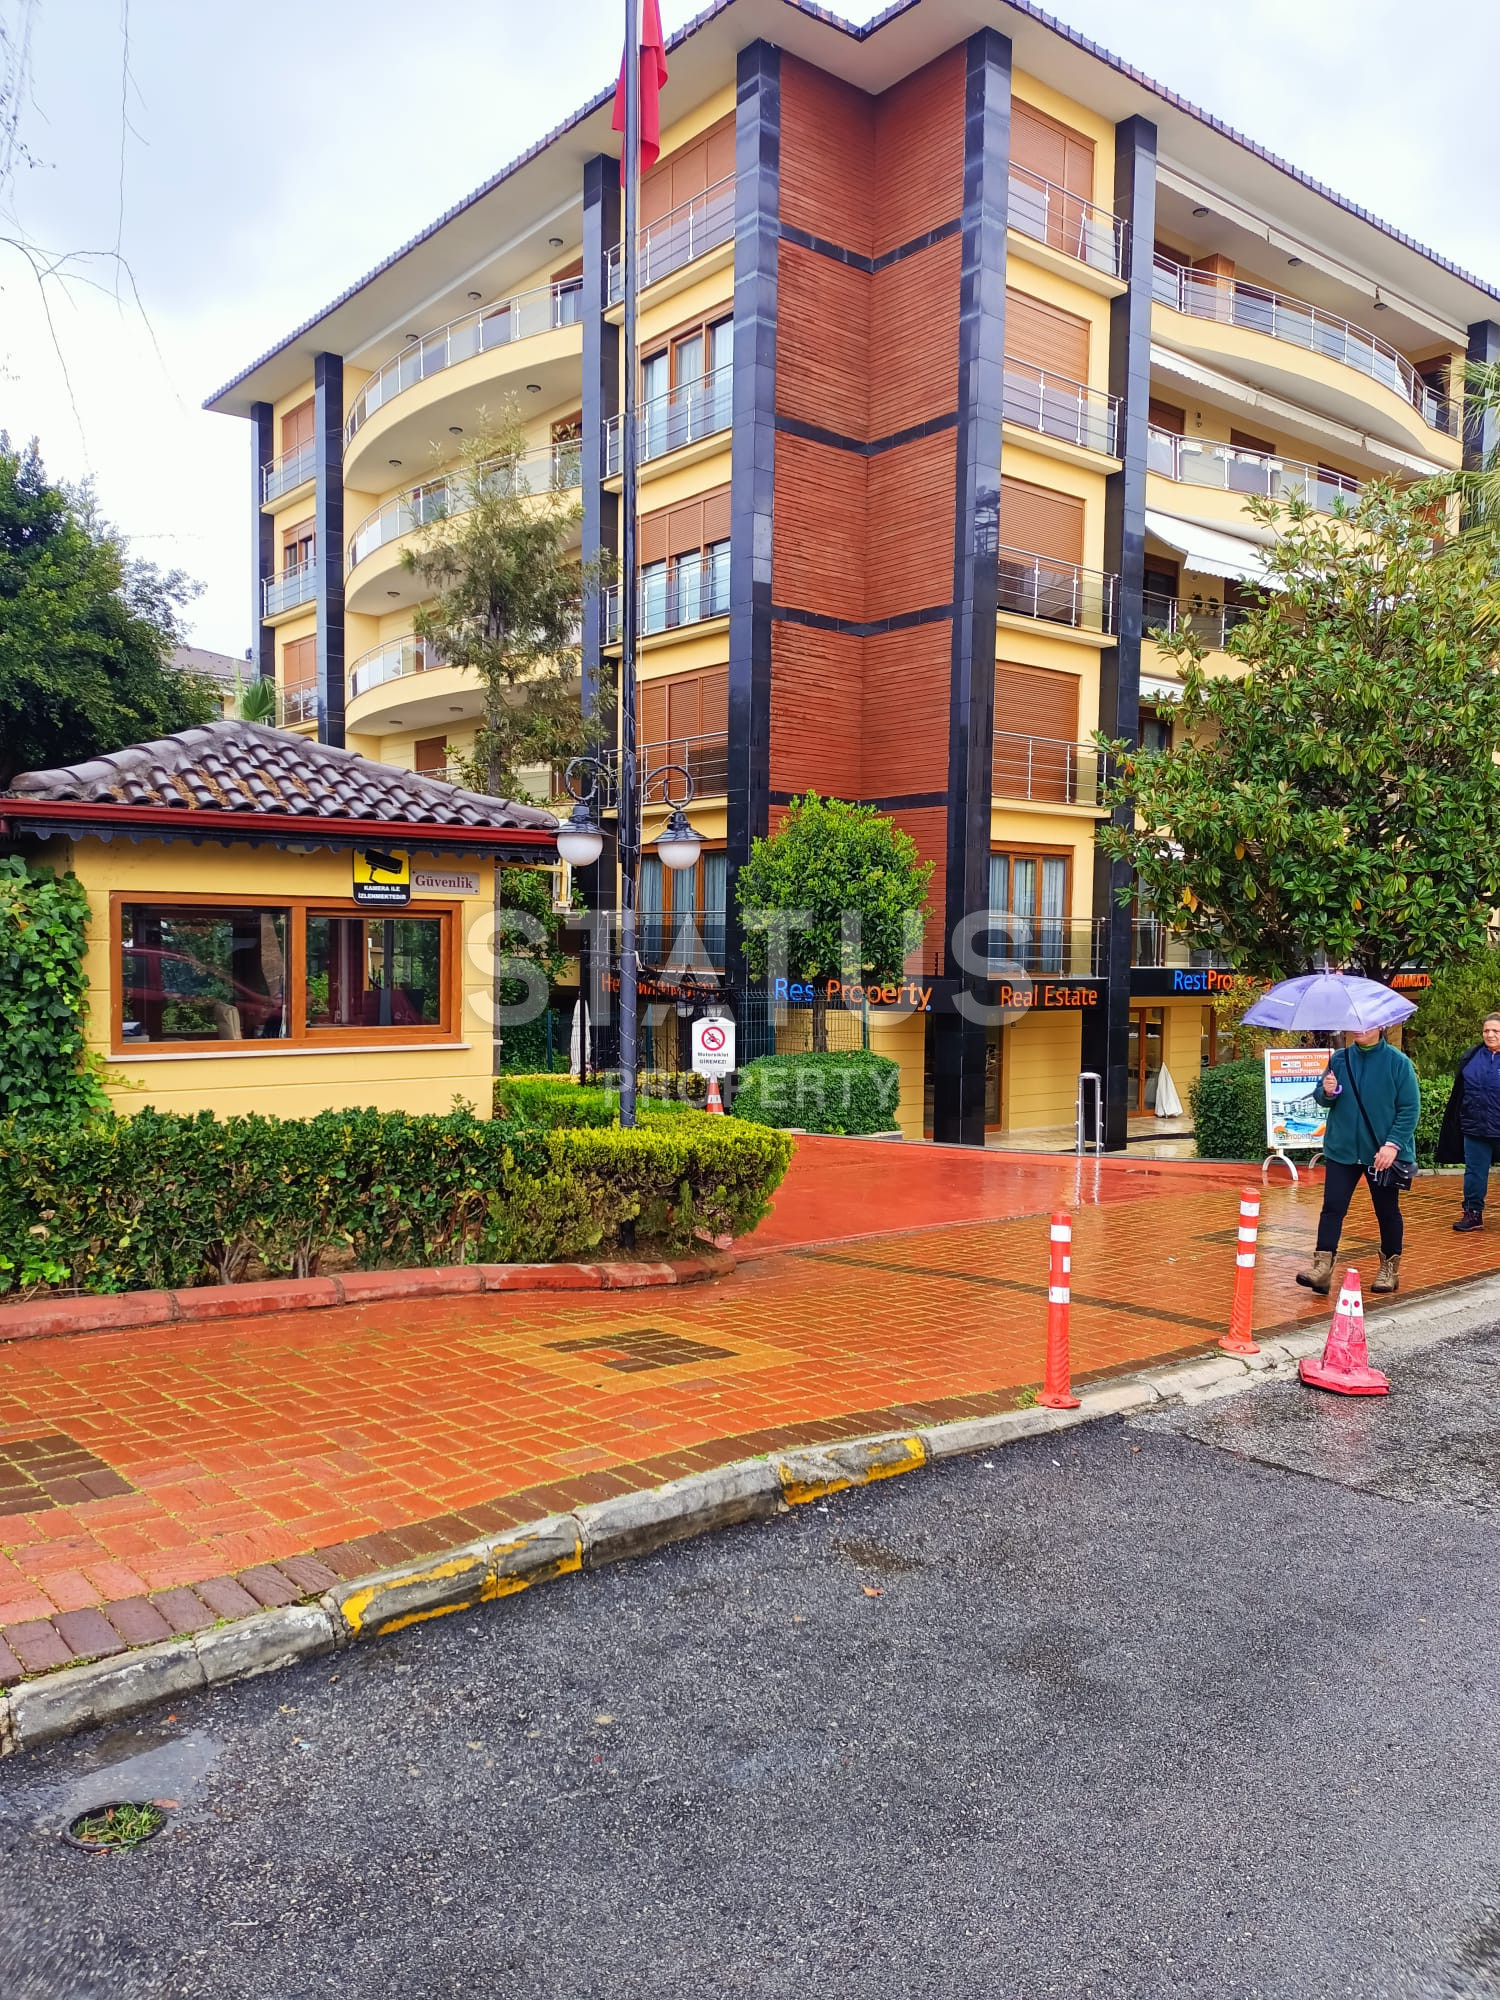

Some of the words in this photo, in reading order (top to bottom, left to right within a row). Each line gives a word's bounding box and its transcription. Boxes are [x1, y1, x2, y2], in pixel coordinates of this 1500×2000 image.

[415, 874, 473, 889] Güvenlik
[1000, 985, 1038, 1008] Real
[1044, 985, 1098, 1006] Estate
